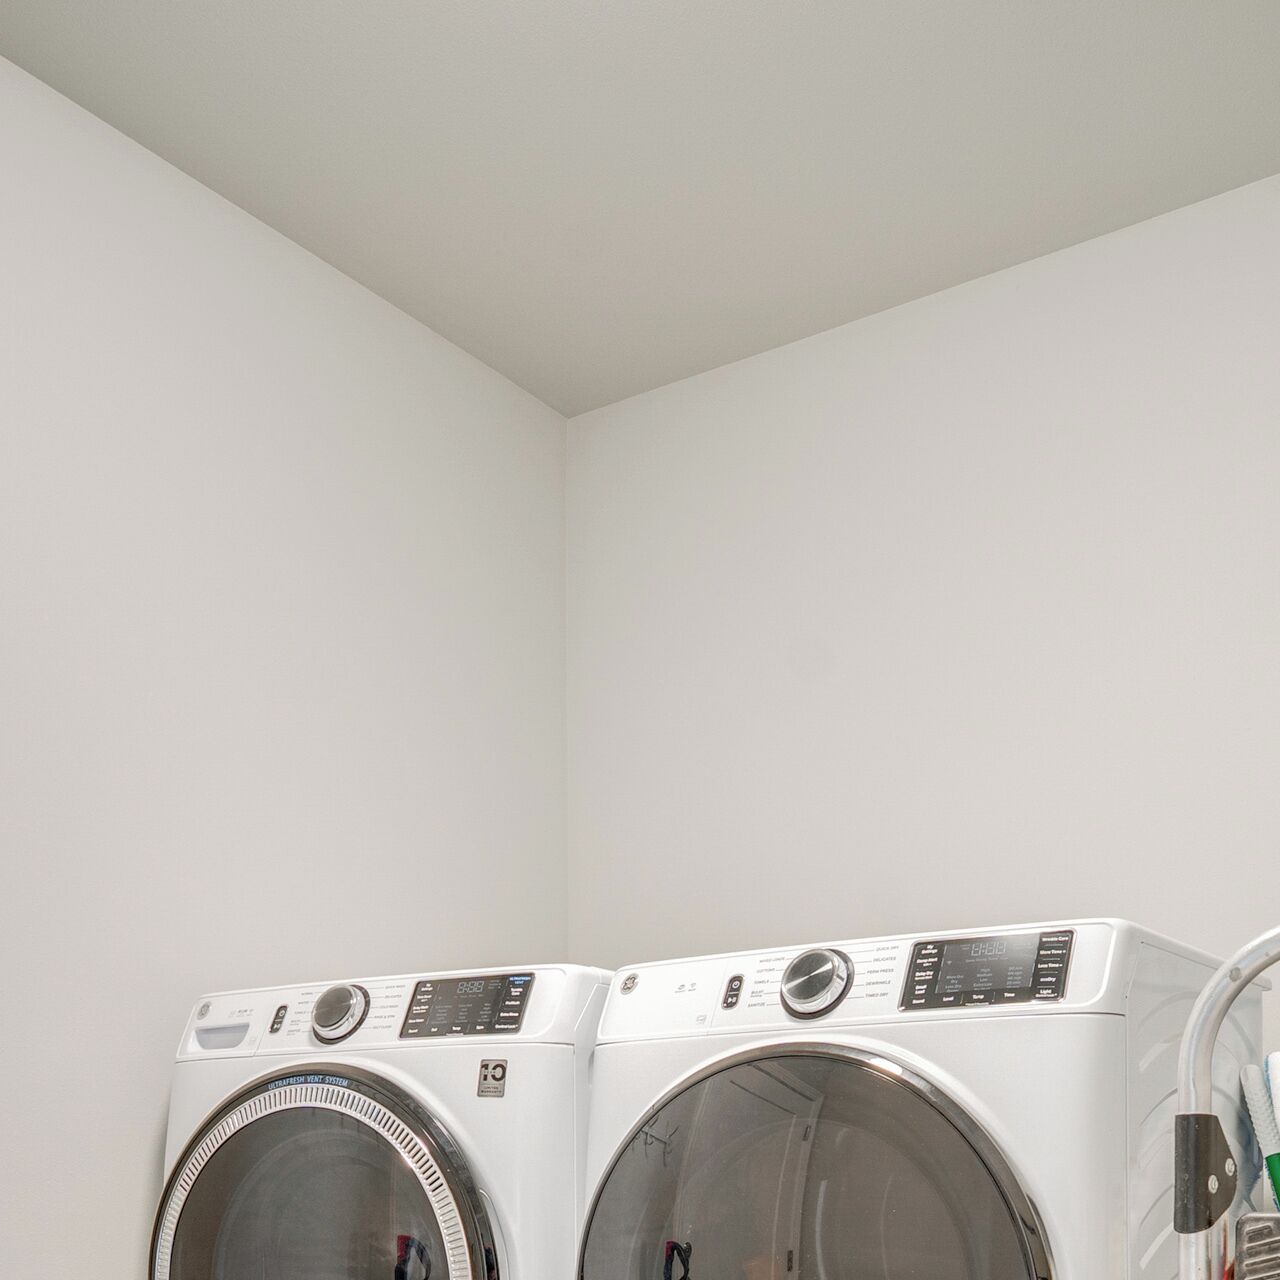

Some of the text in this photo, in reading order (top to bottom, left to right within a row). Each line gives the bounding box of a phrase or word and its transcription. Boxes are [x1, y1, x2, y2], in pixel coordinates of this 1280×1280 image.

[481, 1063, 506, 1081] 10
[268, 1075, 349, 1090] ULTRAFRESH VENT SYSTEM
